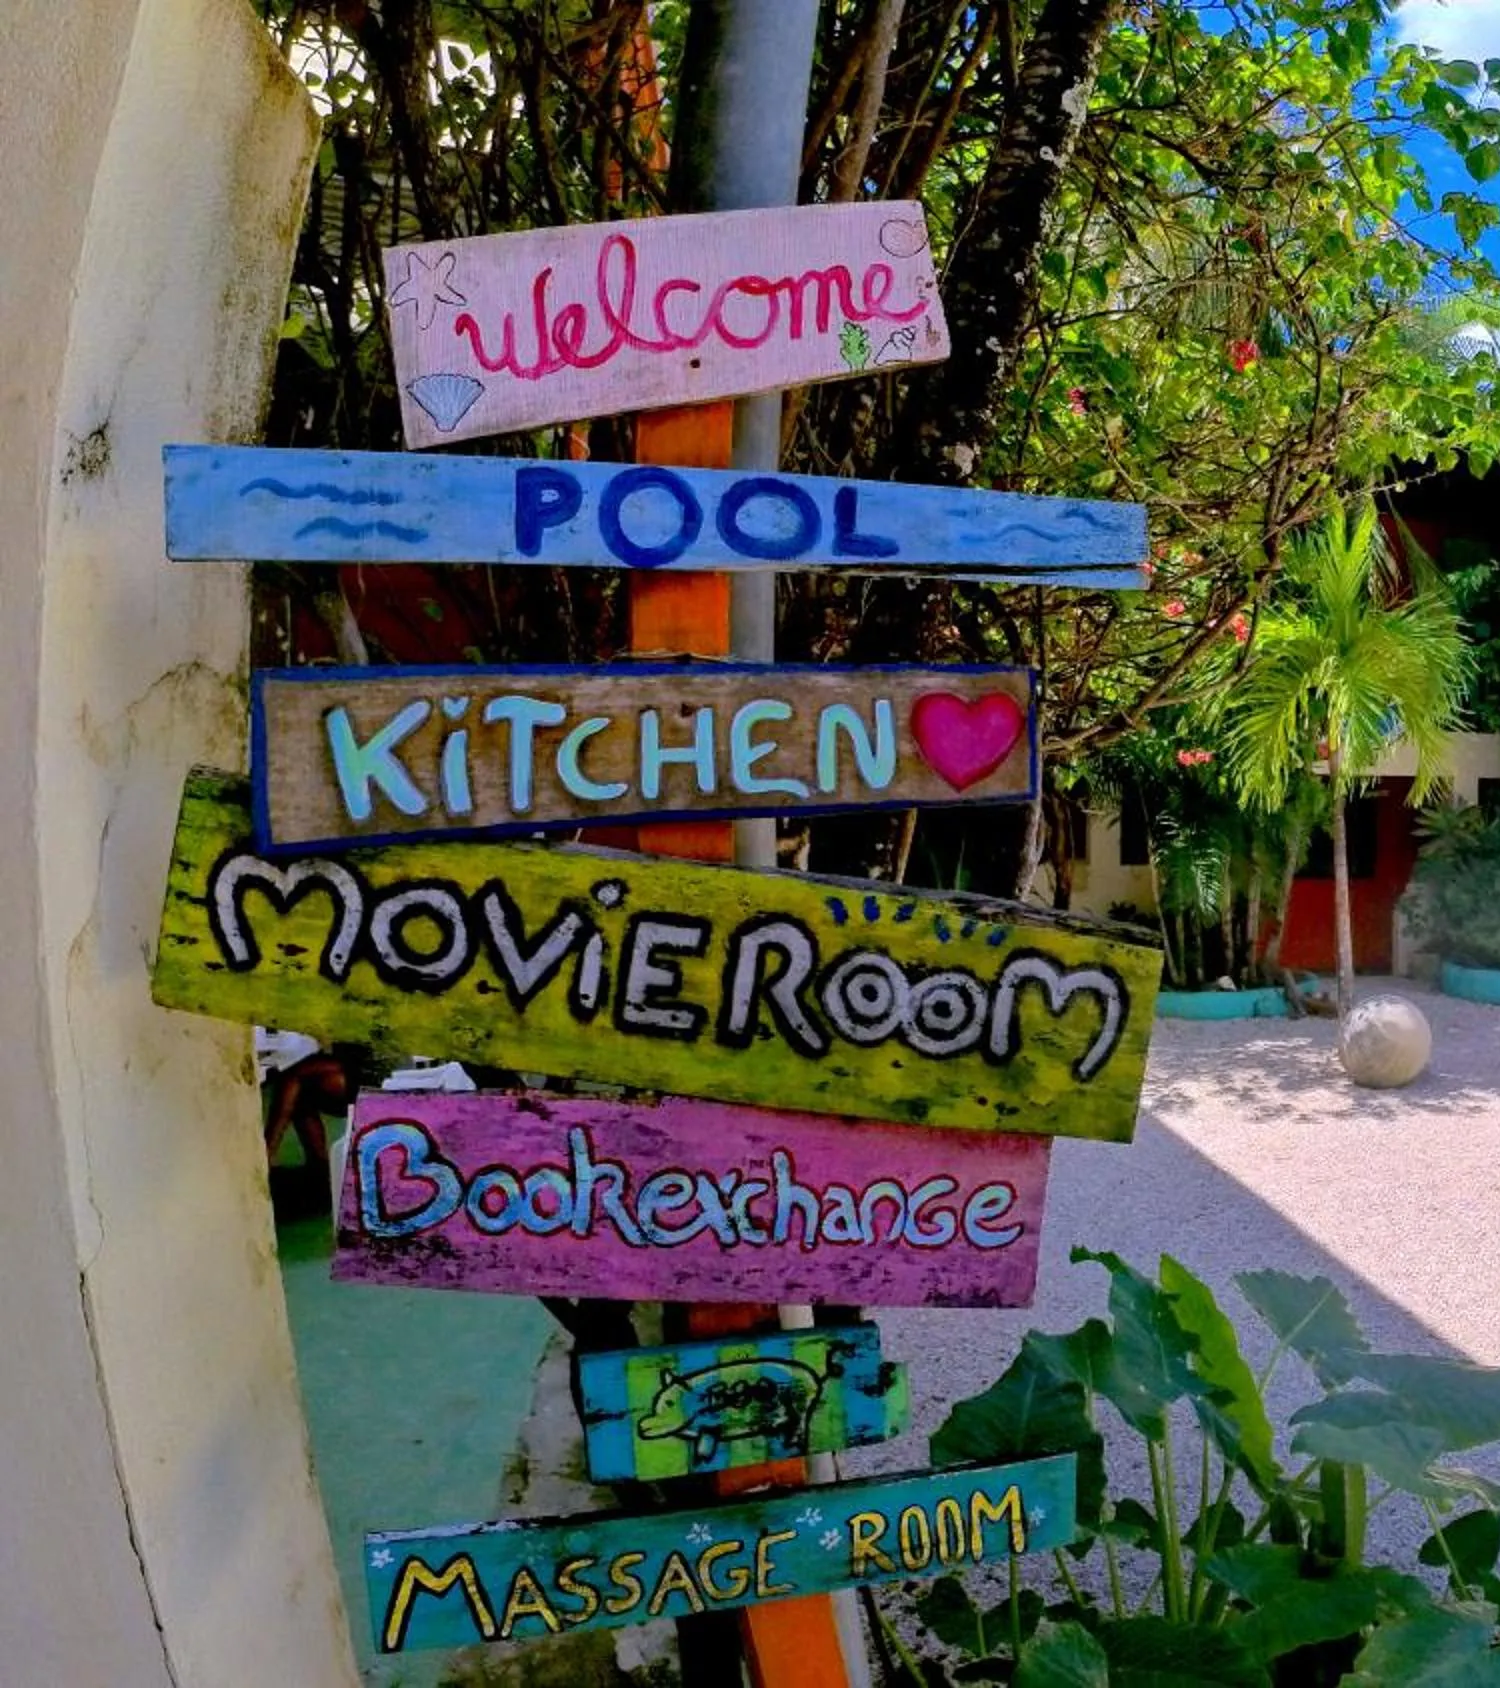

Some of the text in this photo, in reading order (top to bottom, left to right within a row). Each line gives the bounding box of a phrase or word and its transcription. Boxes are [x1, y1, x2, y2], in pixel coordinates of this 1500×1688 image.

[455, 232, 929, 381] Welcome
[514, 465, 900, 568] POOL
[380, 1485, 1028, 1653] MASSAGE ROOM
